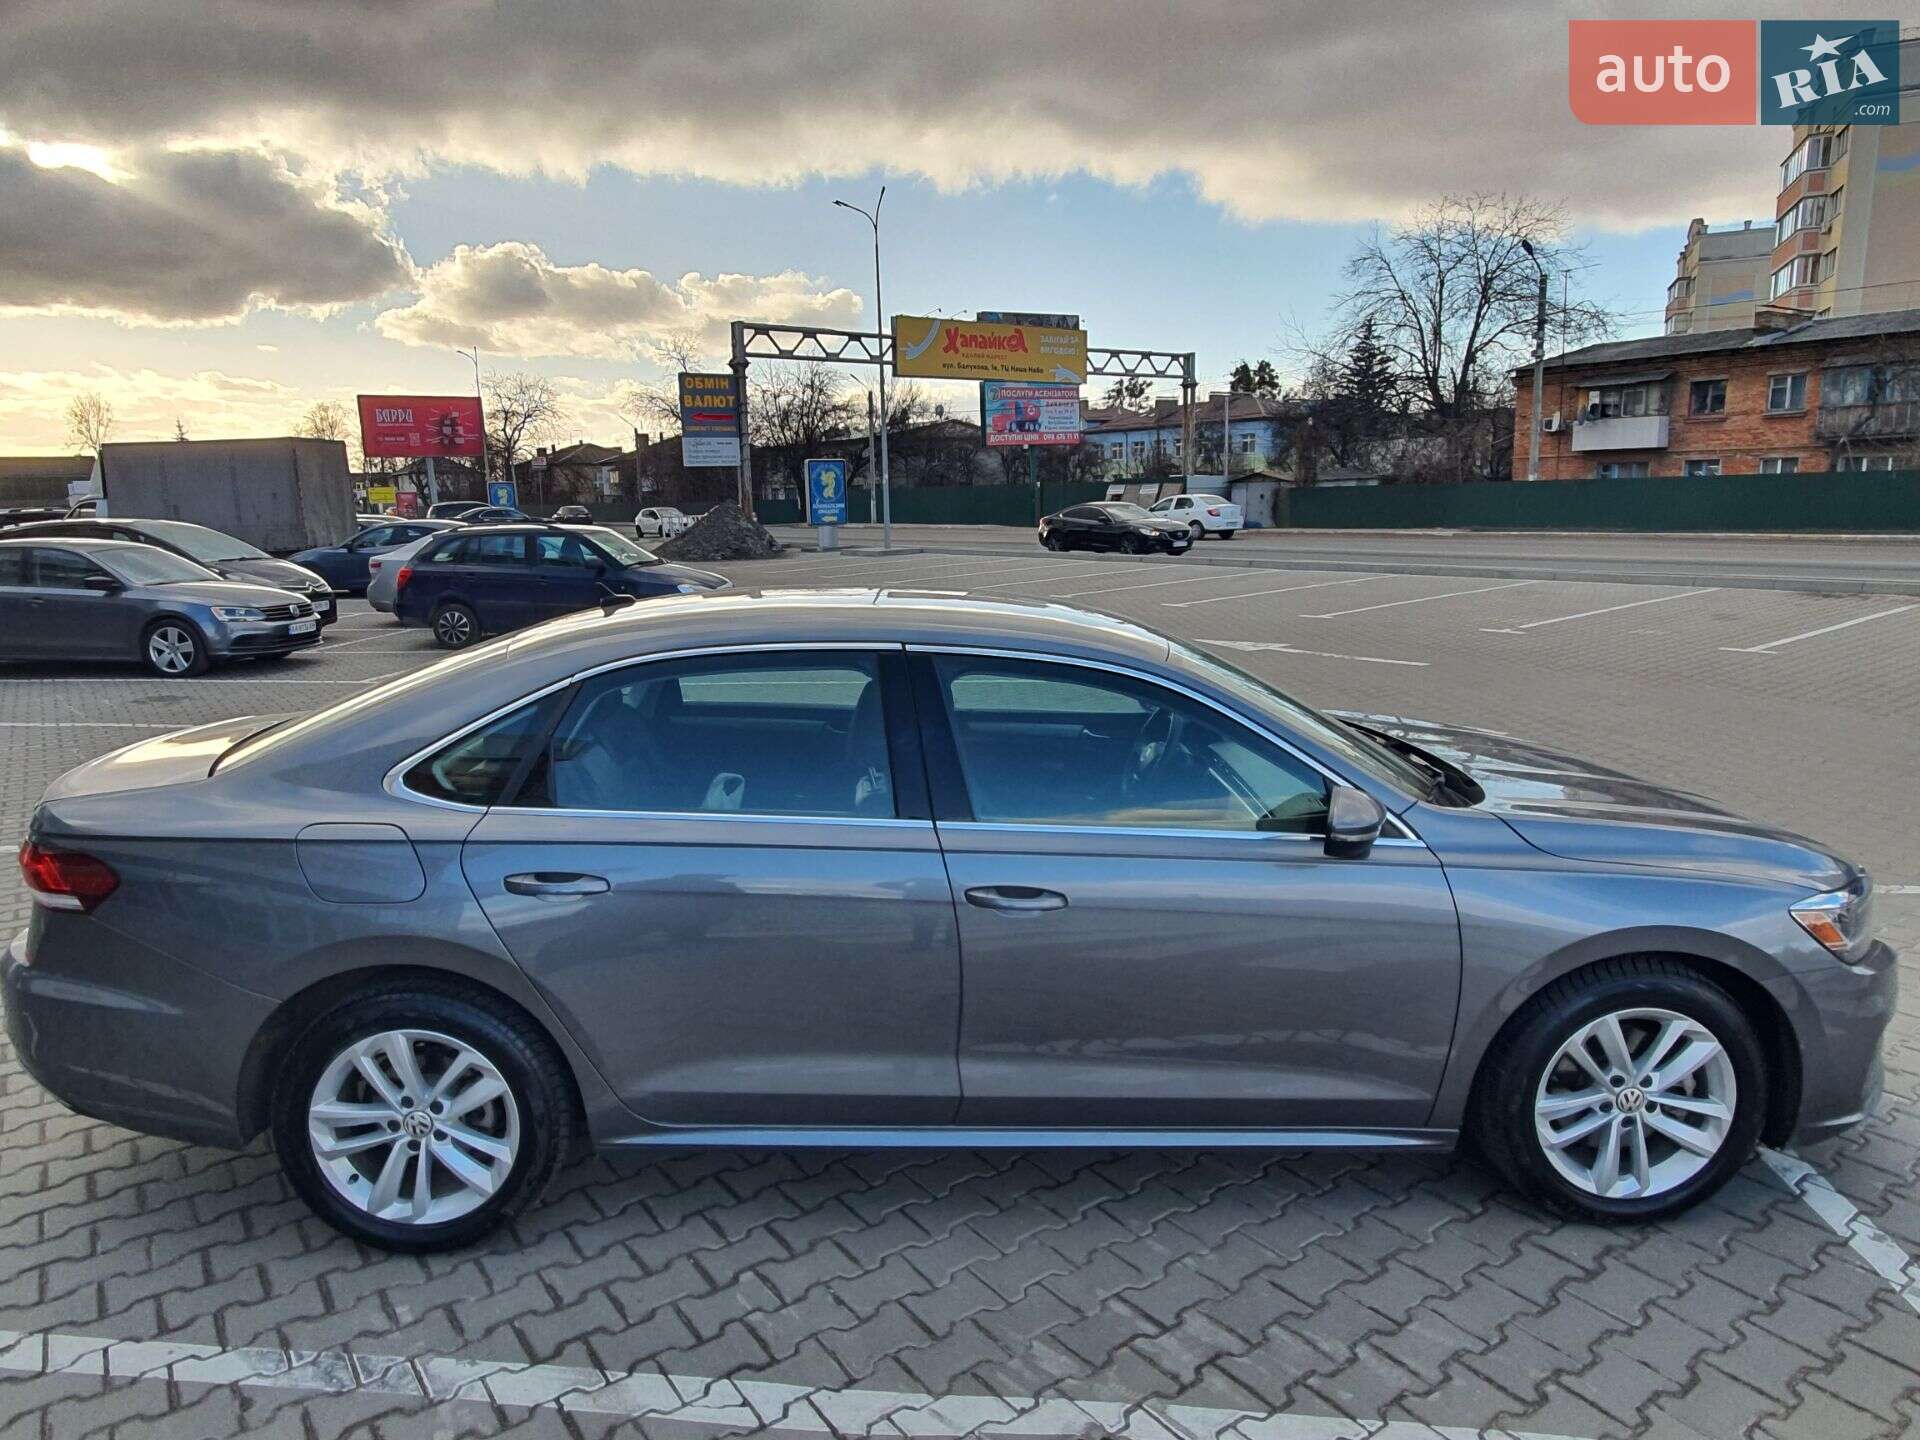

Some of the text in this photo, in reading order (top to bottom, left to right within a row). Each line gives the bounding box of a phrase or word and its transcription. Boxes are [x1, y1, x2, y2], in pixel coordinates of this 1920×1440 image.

[684, 376, 729, 390] ОБМІН
[1001, 389, 1033, 398] ПОСЛУГИ
[683, 394, 736, 408] ВАЛЮТ
